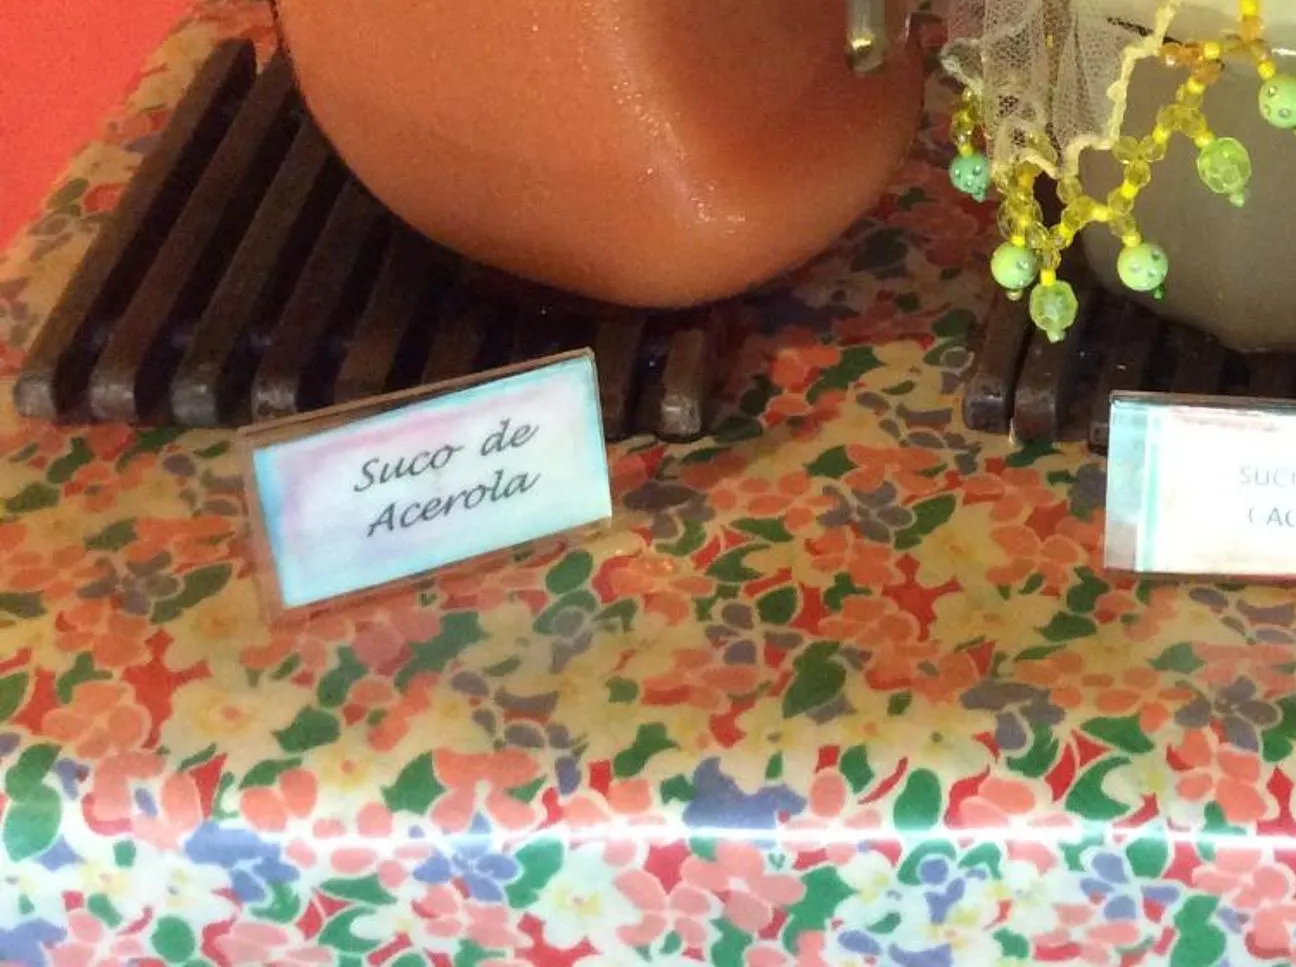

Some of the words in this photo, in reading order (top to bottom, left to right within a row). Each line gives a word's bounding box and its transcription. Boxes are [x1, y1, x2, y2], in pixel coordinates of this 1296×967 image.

[354, 444, 464, 492] Suco
[481, 418, 540, 457] de
[367, 469, 541, 537] Acerola
